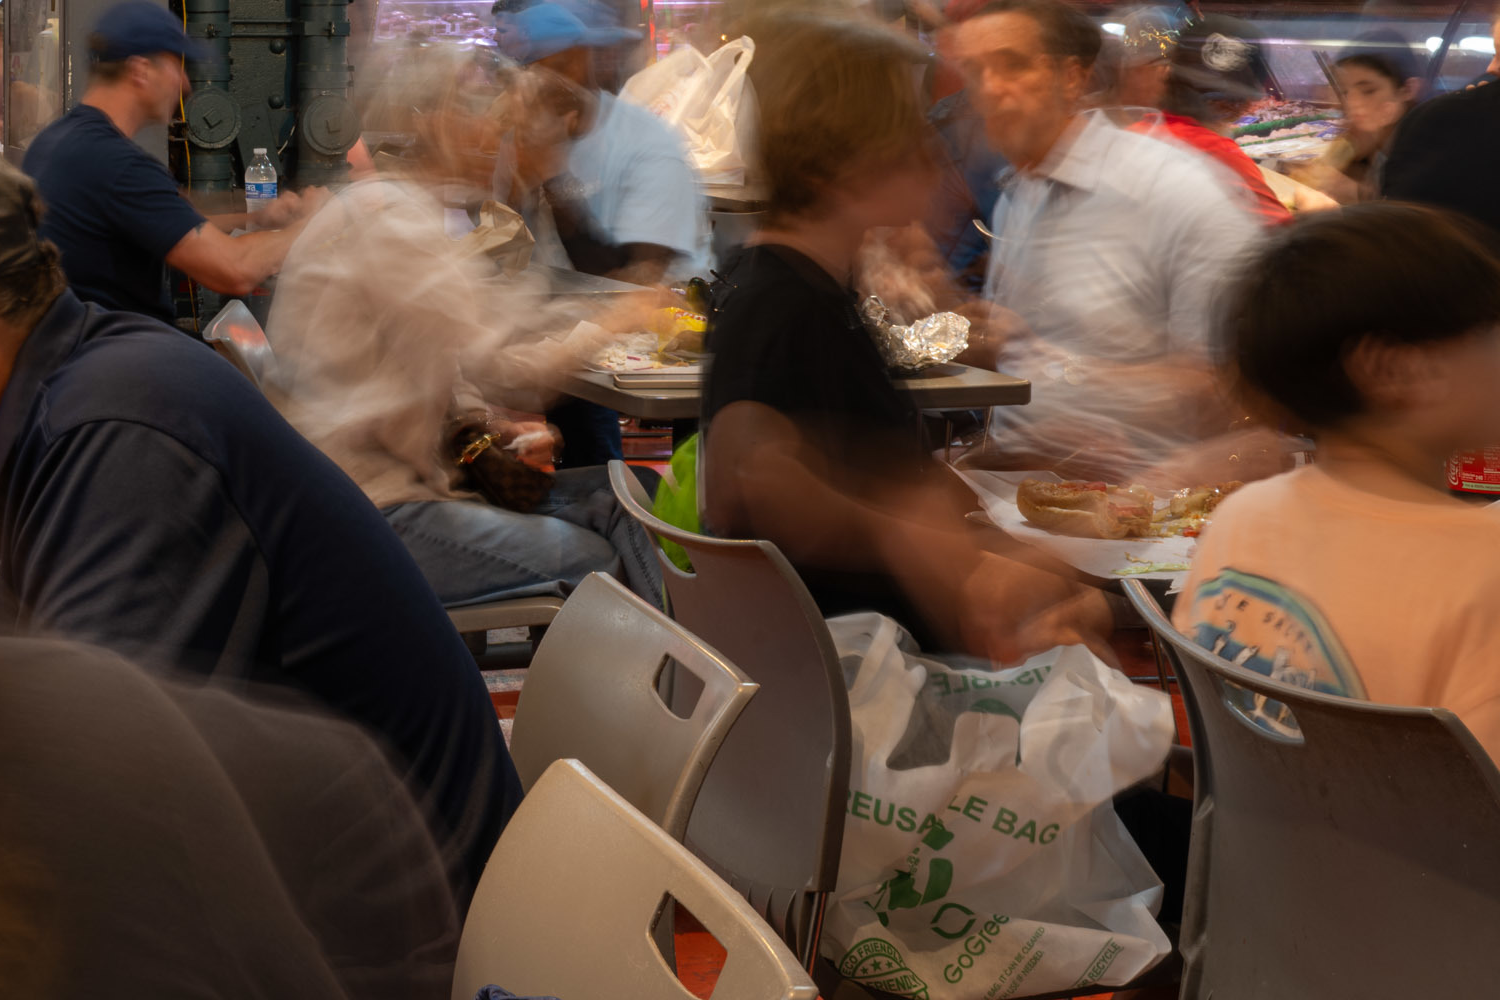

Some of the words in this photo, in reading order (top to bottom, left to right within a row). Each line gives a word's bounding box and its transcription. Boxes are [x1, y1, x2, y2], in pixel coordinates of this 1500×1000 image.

[846, 790, 989, 835] EUSALE
[991, 807, 1060, 845] BAG
[943, 912, 1011, 984] GoGree
[1019, 926, 1046, 955] CLEANED
[842, 954, 858, 976] ECO
[857, 942, 903, 965] FRIENDLY
[1003, 961, 1019, 977] CAN
[1014, 951, 1025, 963] BE
[1086, 941, 1121, 980] RECYCLE
[998, 975, 1007, 985] IT
[1006, 980, 1020, 995] USE
